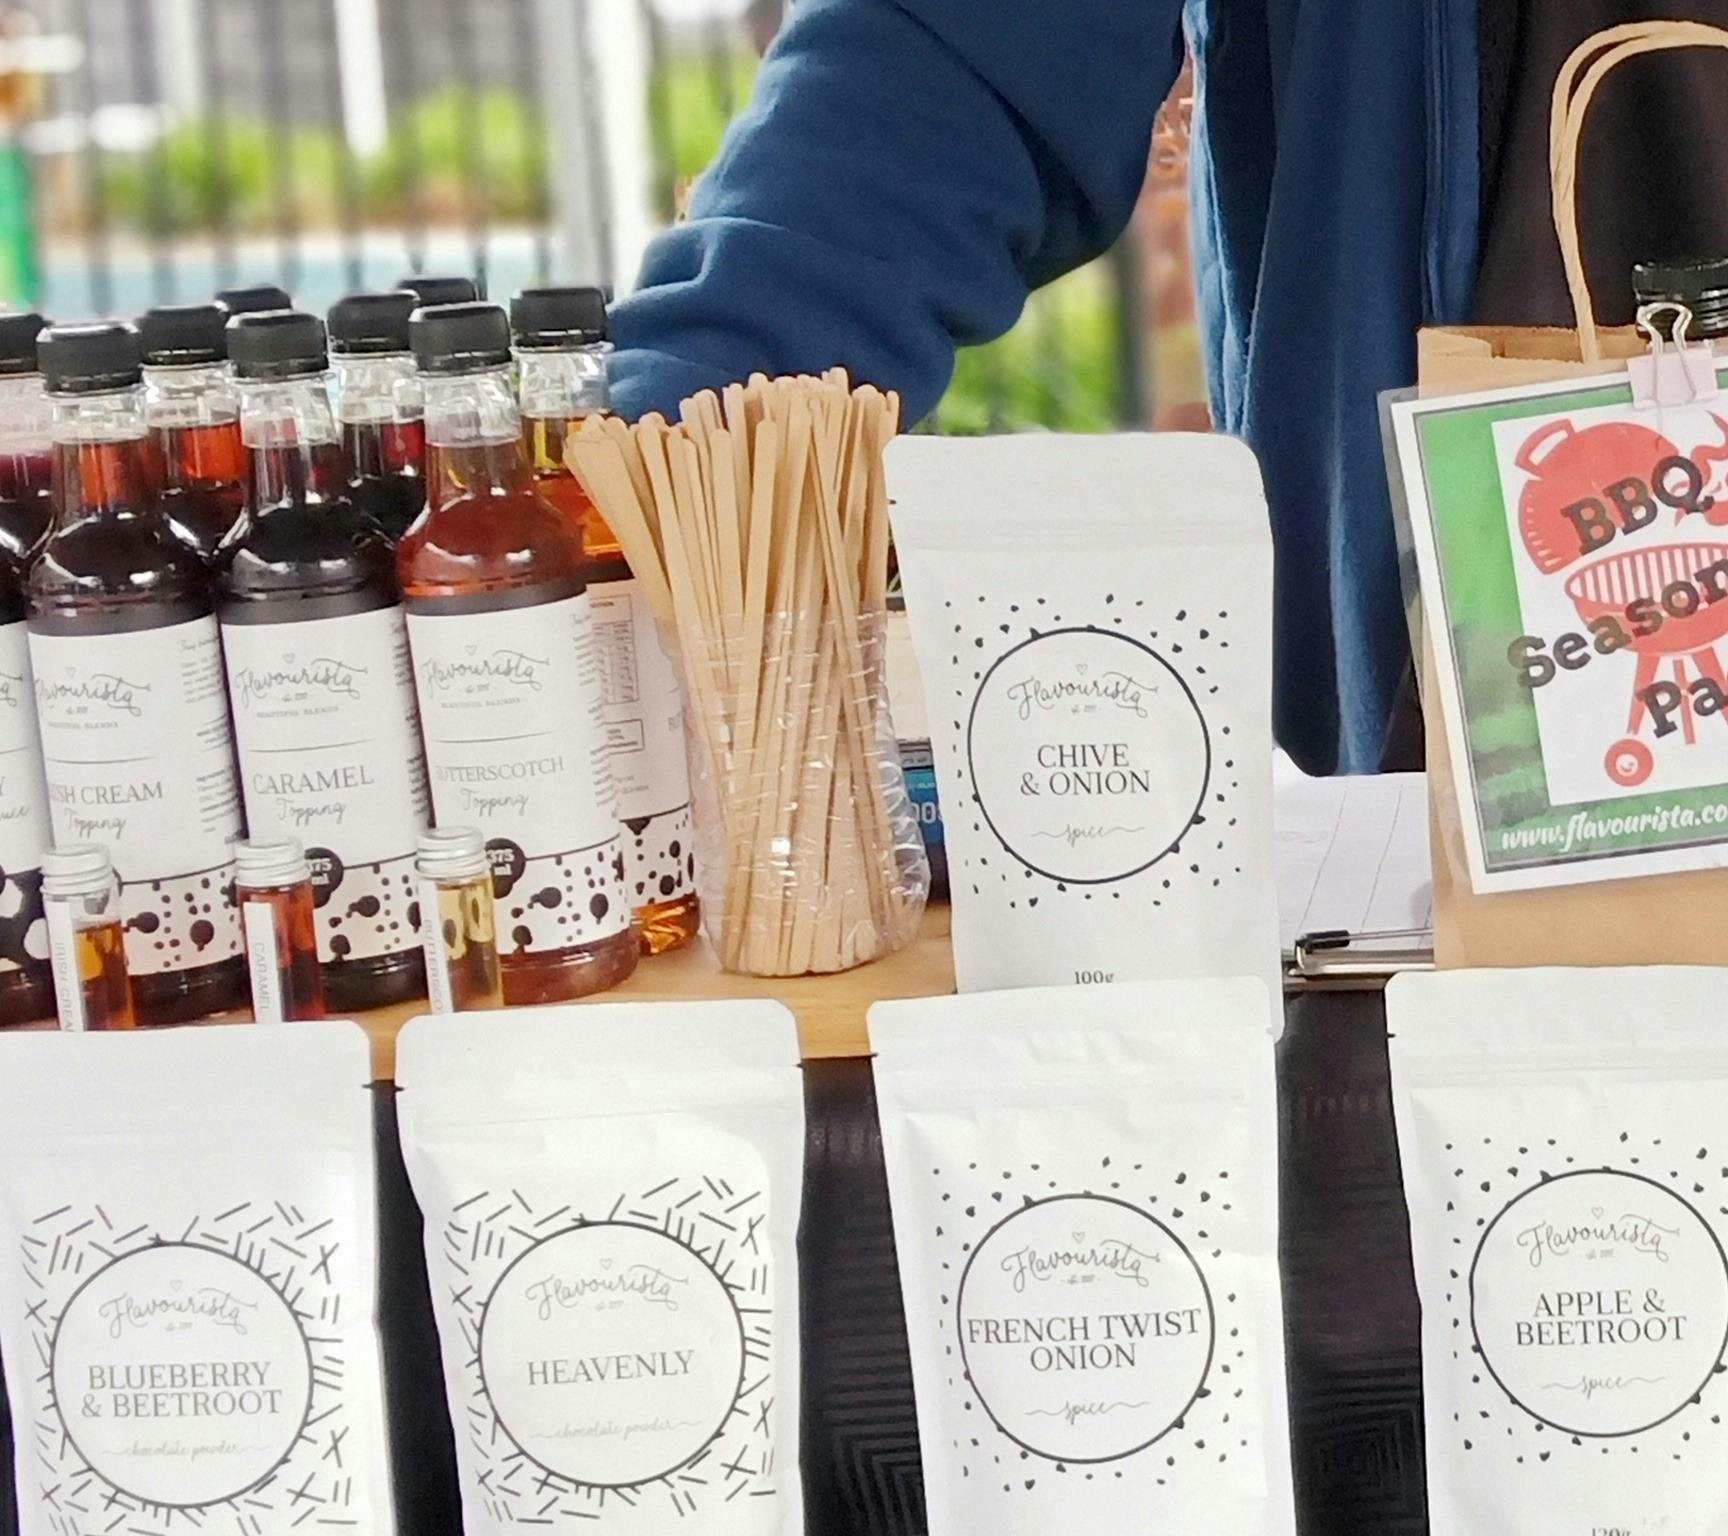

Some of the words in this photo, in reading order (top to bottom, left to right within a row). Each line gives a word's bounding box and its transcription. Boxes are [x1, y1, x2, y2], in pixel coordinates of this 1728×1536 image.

[1560, 455, 1716, 556] BBQ
[1006, 669, 1159, 720] Flavourista
[1037, 744, 1130, 768] CHIVE
[81, 781, 164, 805] CREAM
[253, 765, 375, 795] CARAMEL
[1021, 774, 1040, 796] &
[1049, 770, 1151, 796] ONION
[276, 797, 347, 828] Topping
[460, 787, 529, 816] Topping
[253, 941, 272, 1013] CARAMEL
[1517, 1214, 1680, 1268] Flavourista
[1000, 1239, 1160, 1293] Flavourista
[524, 1264, 690, 1321] Flavourista
[1533, 1289, 1634, 1318] APPLE
[1643, 1288, 1666, 1314] &
[99, 1286, 259, 1339] Flavourista
[967, 1315, 1091, 1344] FRENCH
[1099, 1308, 1203, 1340] TWIST
[1516, 1316, 1687, 1346] BEETROOT
[528, 1349, 695, 1386] HEAVENLY
[1030, 1342, 1138, 1372] ONION
[88, 1361, 272, 1391] BLUEBERRY
[81, 1395, 102, 1418] &
[112, 1389, 283, 1418] BEETROOT
